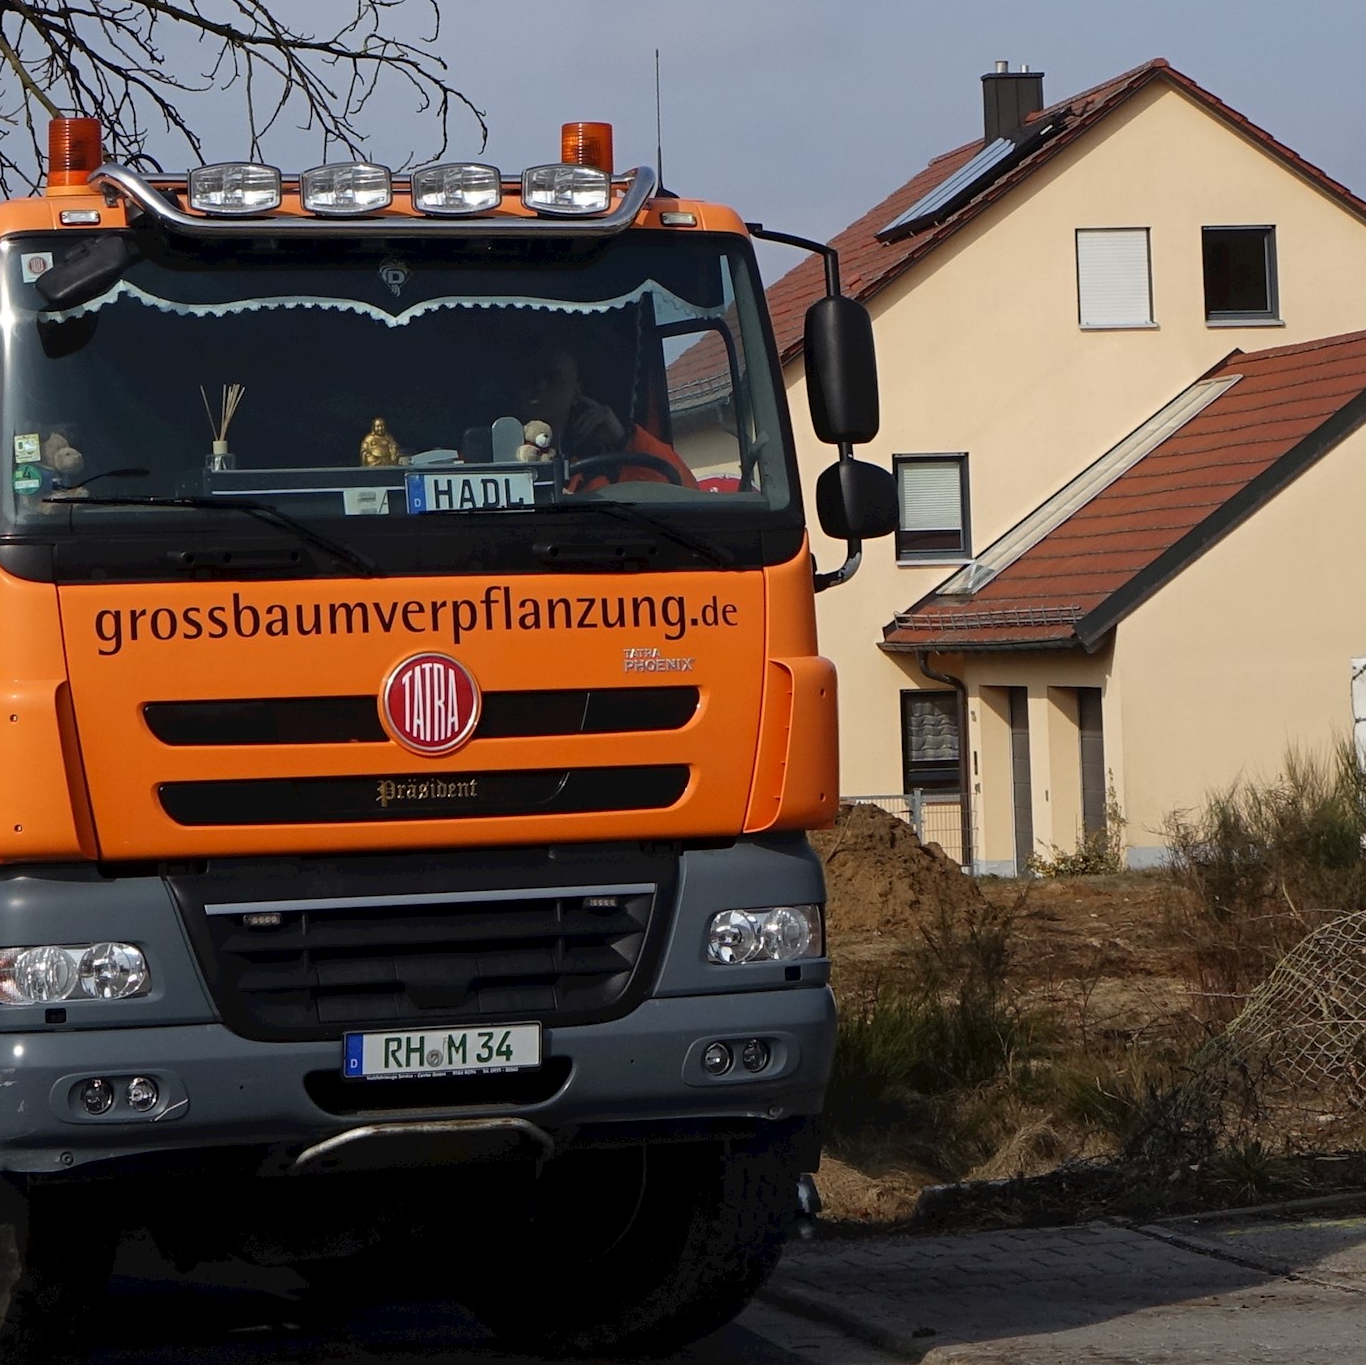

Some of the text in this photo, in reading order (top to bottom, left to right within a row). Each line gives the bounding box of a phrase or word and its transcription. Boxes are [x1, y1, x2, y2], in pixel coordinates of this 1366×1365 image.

[414, 498, 422, 508] D
[94, 585, 738, 656] grossbaumverpflanzung.de
[623, 647, 661, 659] TATRA
[623, 657, 693, 673] PHOENIX
[401, 662, 460, 742] TATRA
[350, 1030, 514, 1069] D RH M 34
